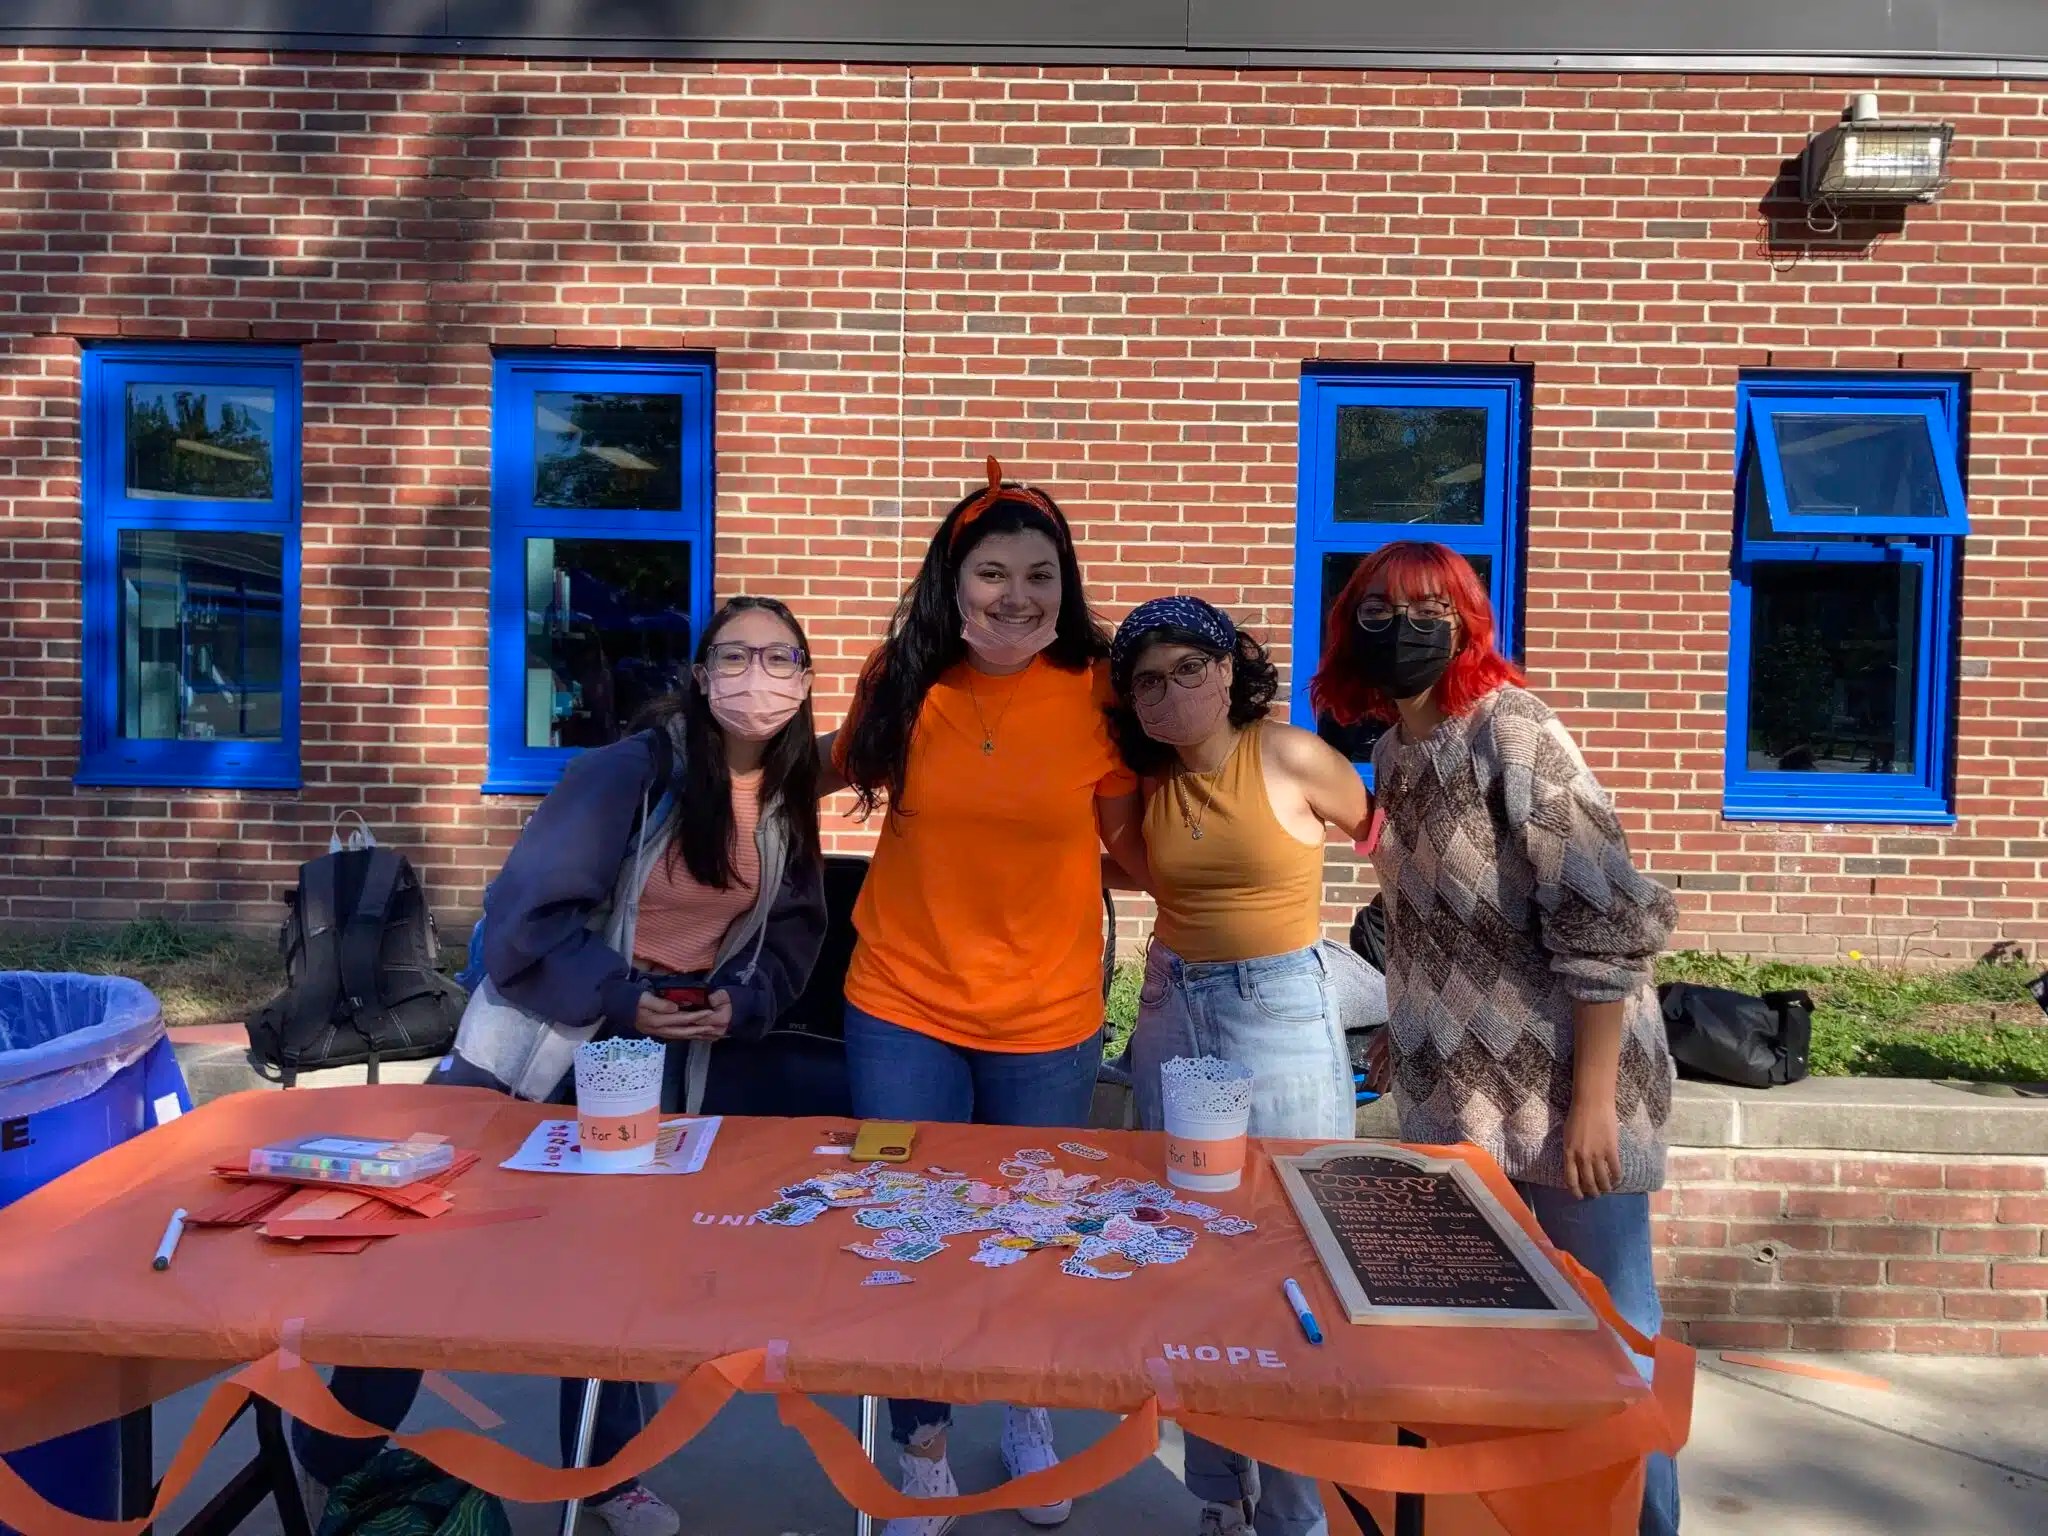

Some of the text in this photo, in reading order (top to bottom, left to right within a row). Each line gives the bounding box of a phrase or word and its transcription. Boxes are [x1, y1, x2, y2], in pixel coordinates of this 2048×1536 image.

[591, 1126, 612, 1141] for
[617, 1124, 637, 1142] $1
[1168, 1144, 1207, 1168] for $1
[1310, 1173, 1437, 1193] UNITY
[1319, 1188, 1412, 1206] DAY
[1433, 1239, 1446, 1247] to
[1459, 1274, 1480, 1282] the
[1163, 1343, 1287, 1368] HOPE
